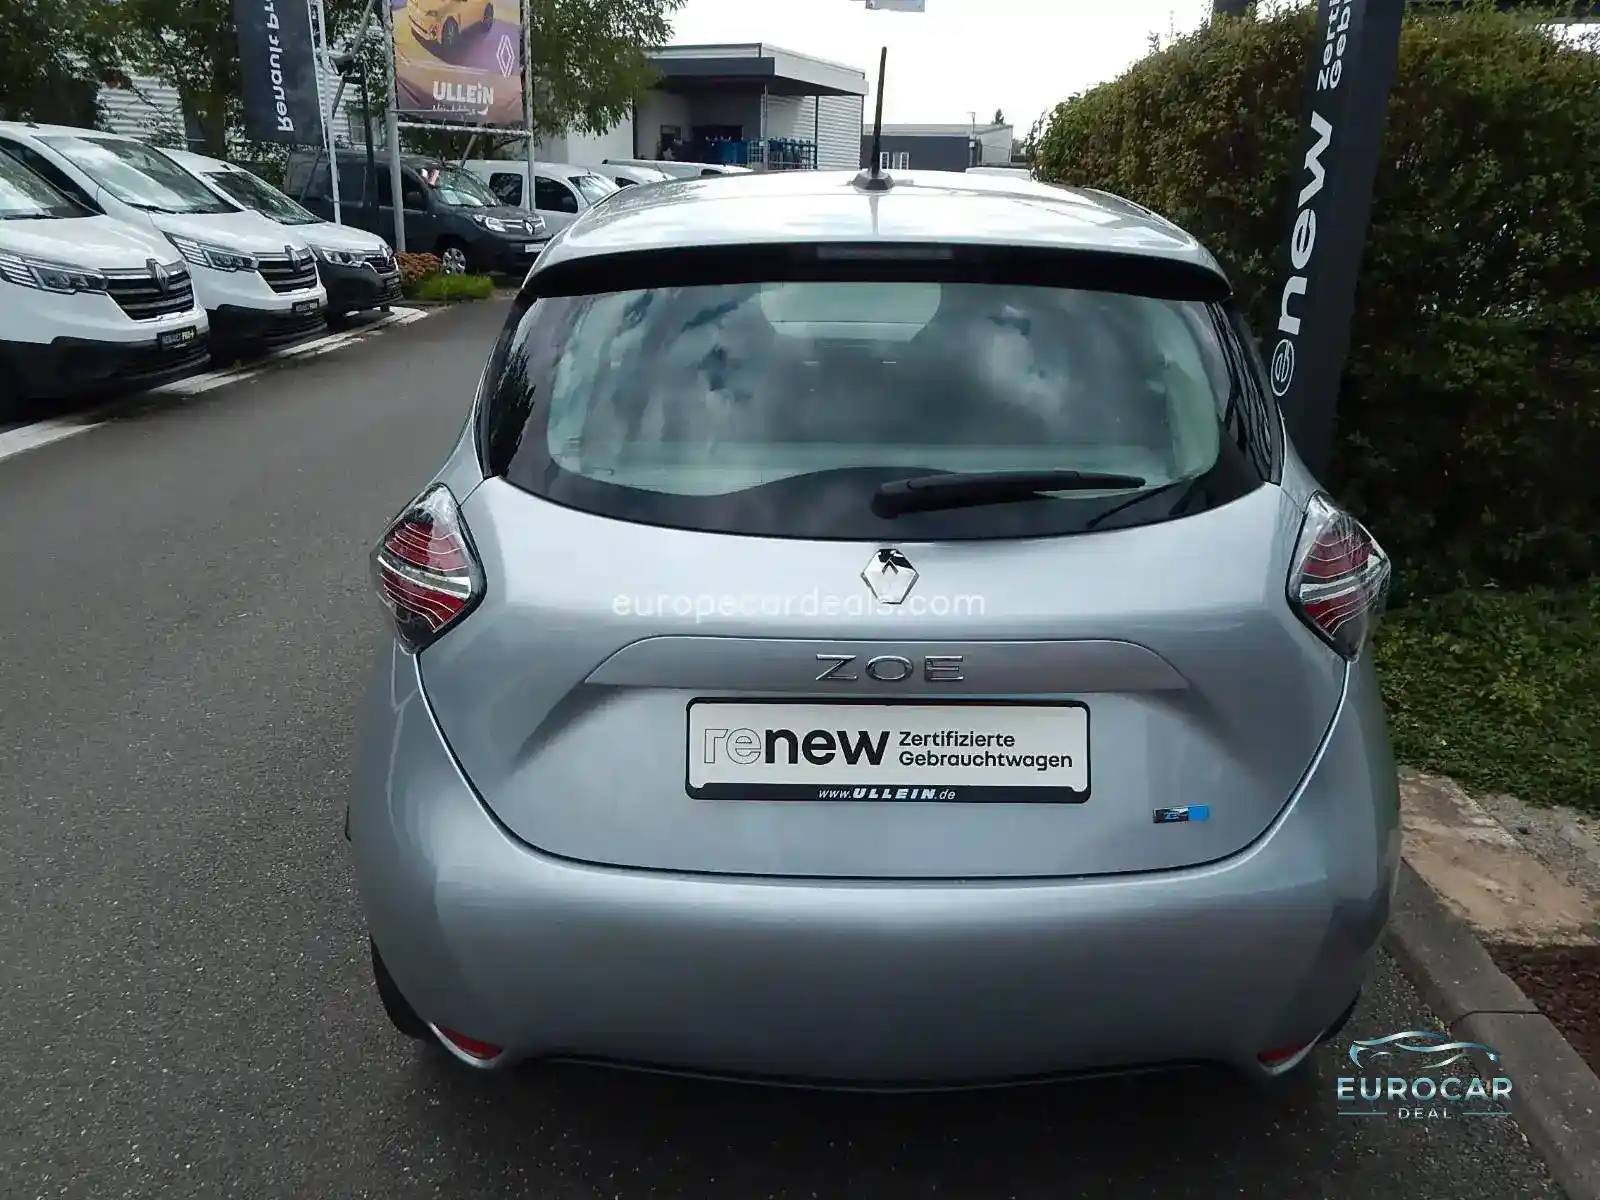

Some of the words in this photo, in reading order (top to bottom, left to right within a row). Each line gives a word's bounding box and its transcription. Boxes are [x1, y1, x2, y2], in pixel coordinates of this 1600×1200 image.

[815, 653, 965, 682] ZOE
[704, 728, 890, 766] renew
[899, 730, 1016, 748] Zertifizierte
[899, 750, 1073, 772] Gebrauchtwagen
[818, 788, 956, 801] www.ULLEIN.de
